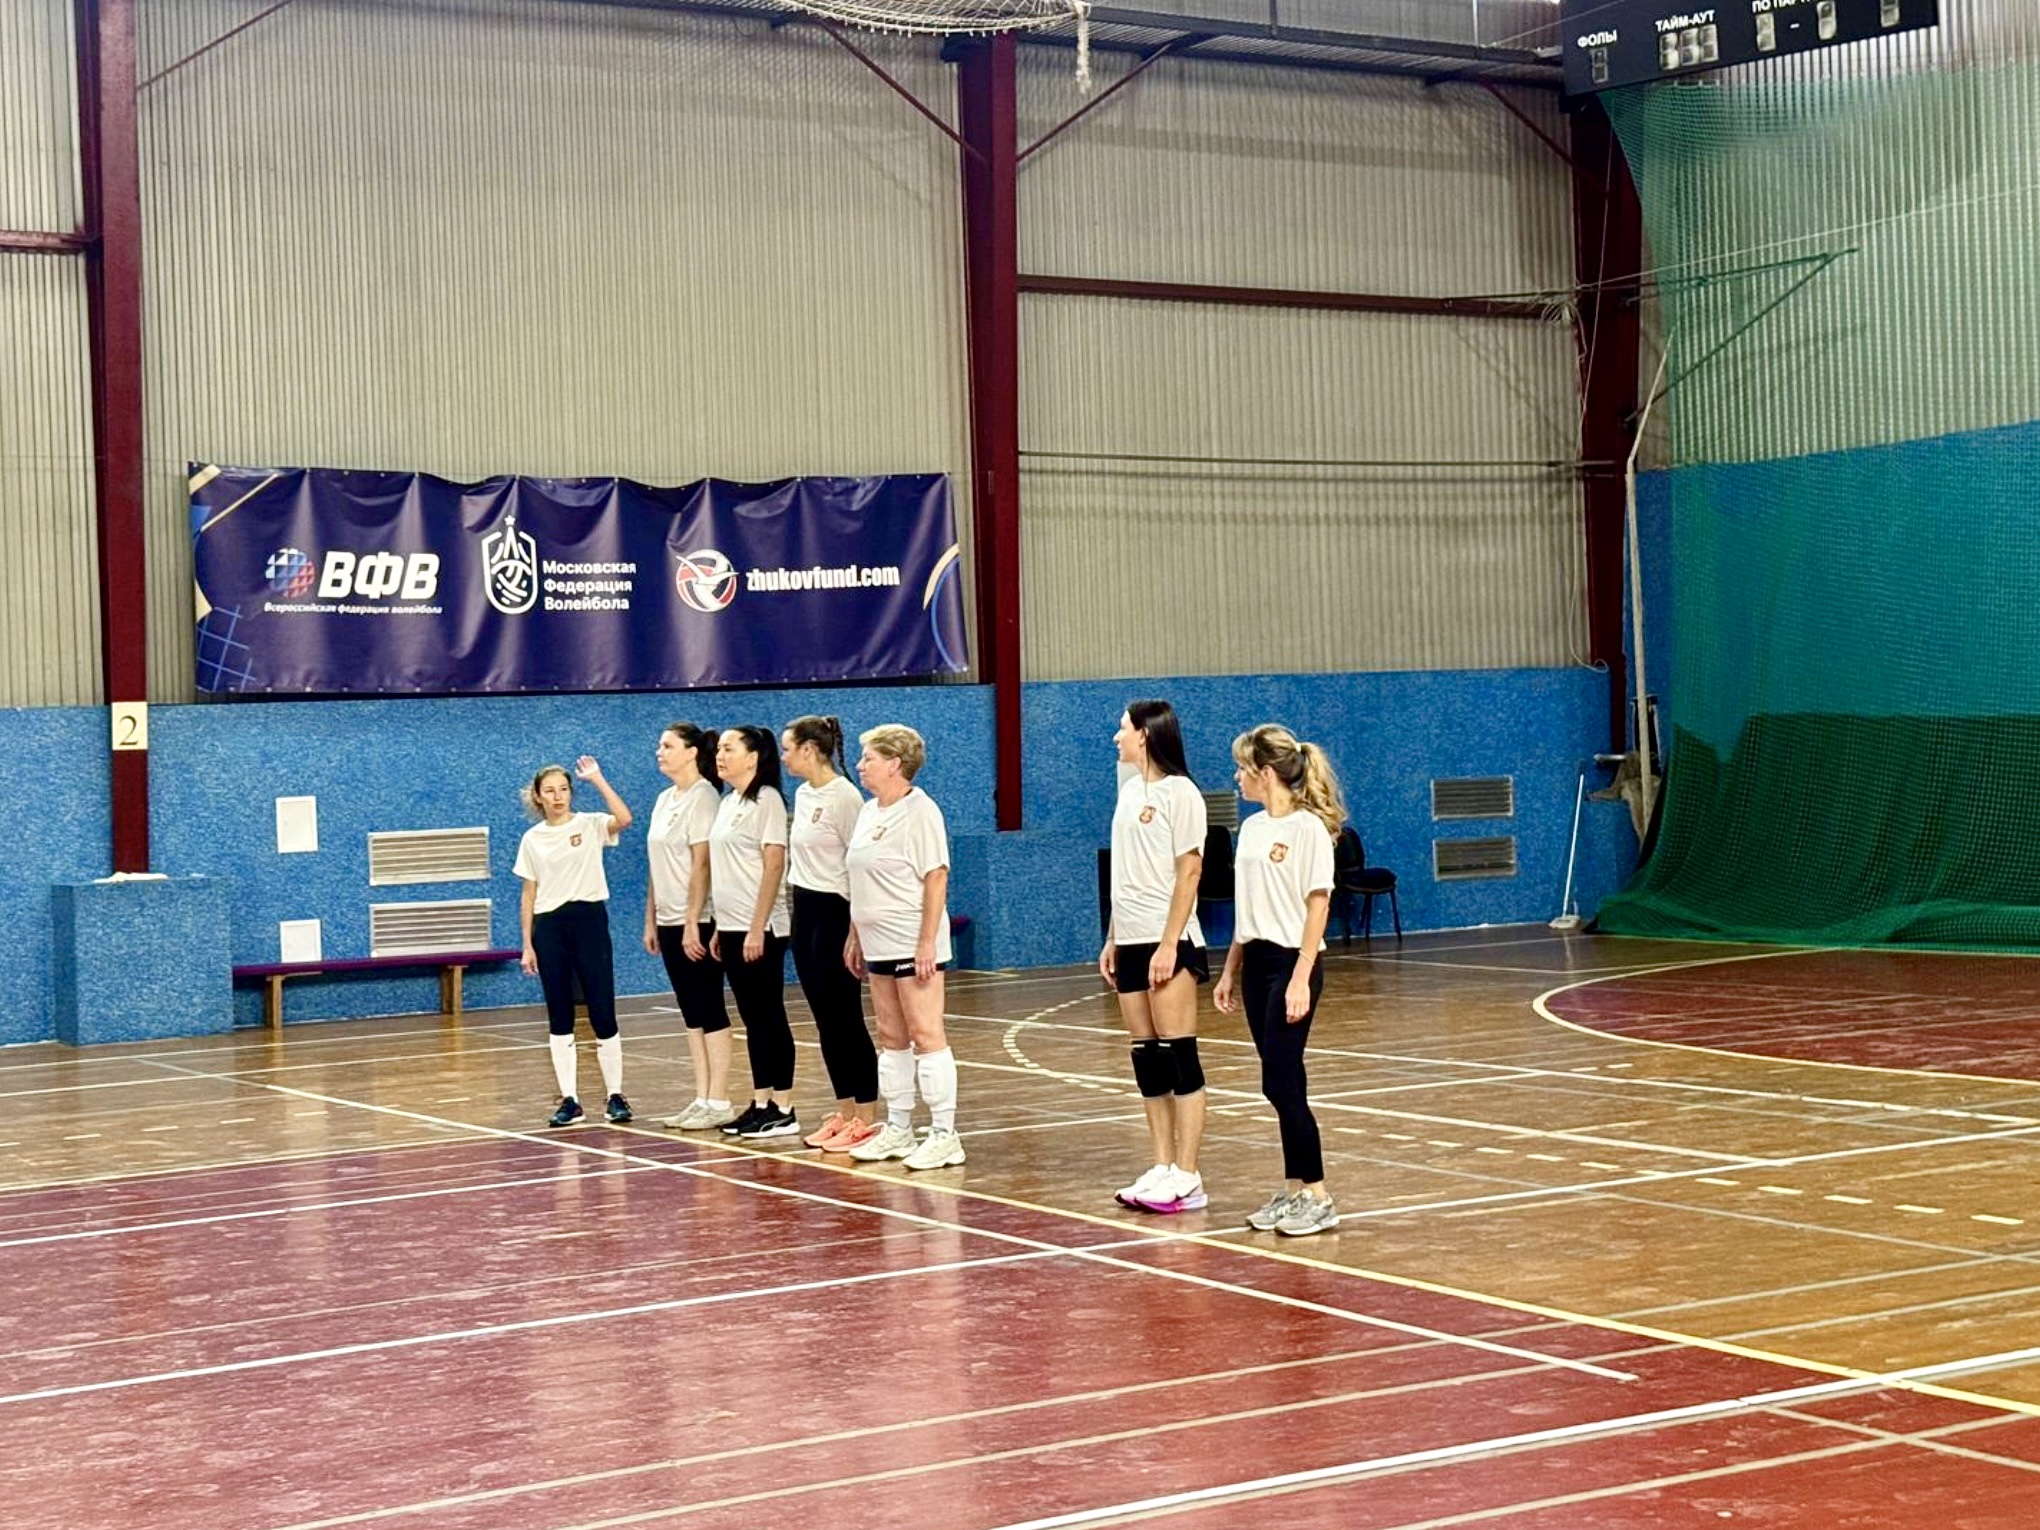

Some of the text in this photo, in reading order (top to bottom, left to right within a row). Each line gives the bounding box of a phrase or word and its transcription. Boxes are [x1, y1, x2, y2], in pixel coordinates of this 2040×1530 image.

[1752, 0, 1771, 13] ПО
[1655, 10, 1715, 32] ТАЙМ-АУТ
[1577, 30, 1617, 48] ФОЛЫ
[317, 551, 440, 600] ВФВ
[542, 561, 637, 574] Московская
[543, 578, 633, 594] Федерация
[746, 564, 901, 591] zhukovfund.com
[264, 602, 442, 615] Всероссийская федерация волейбола
[544, 596, 630, 611] Волейбола
[119, 715, 139, 746] 2
